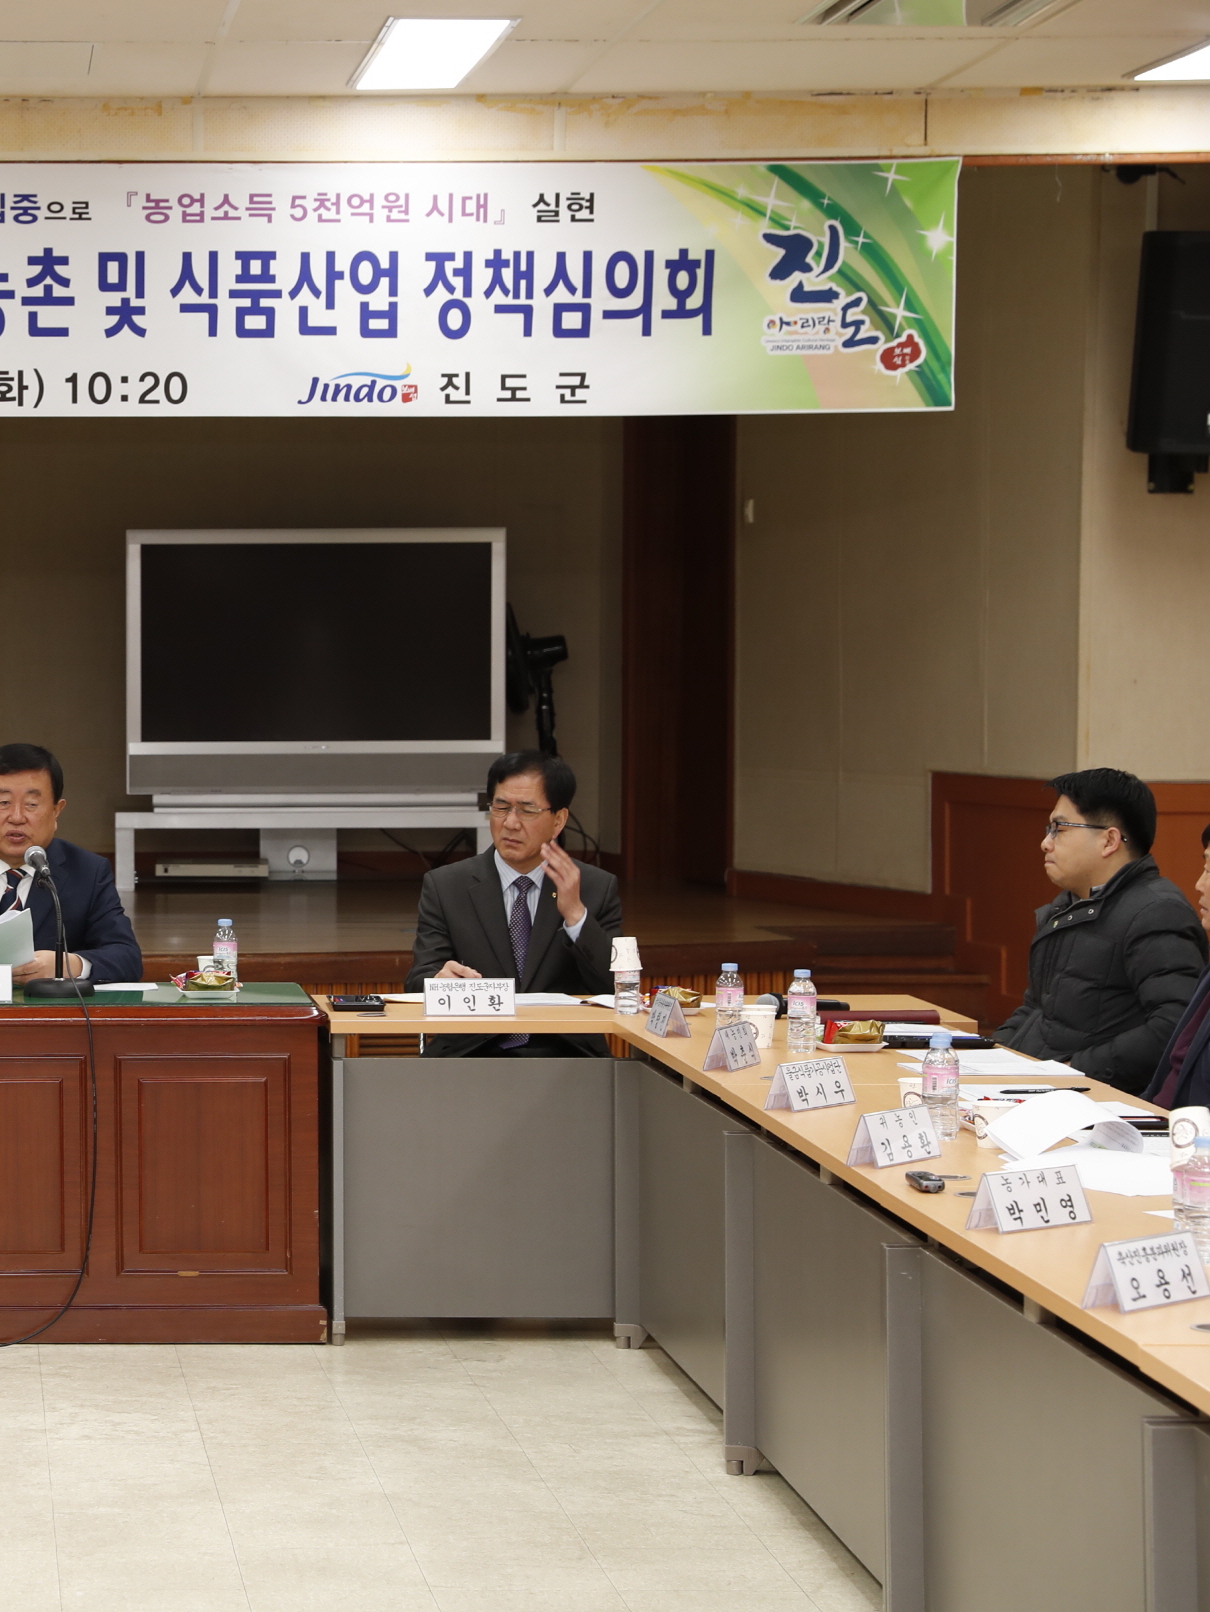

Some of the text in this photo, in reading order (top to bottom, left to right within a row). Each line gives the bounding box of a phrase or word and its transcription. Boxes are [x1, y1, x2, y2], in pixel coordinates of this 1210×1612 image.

[289, 192, 410, 224] 5천억원
[530, 192, 596, 224] 실현
[97, 249, 147, 339] 및
[169, 249, 399, 339] 식품산업
[422, 248, 716, 341] 정책심의회
[770, 344, 794, 352] JINDO
[65, 371, 189, 405] 10:20
[297, 376, 398, 405] Jindo
[785, 1060, 842, 1081] 울금식품가공사업단
